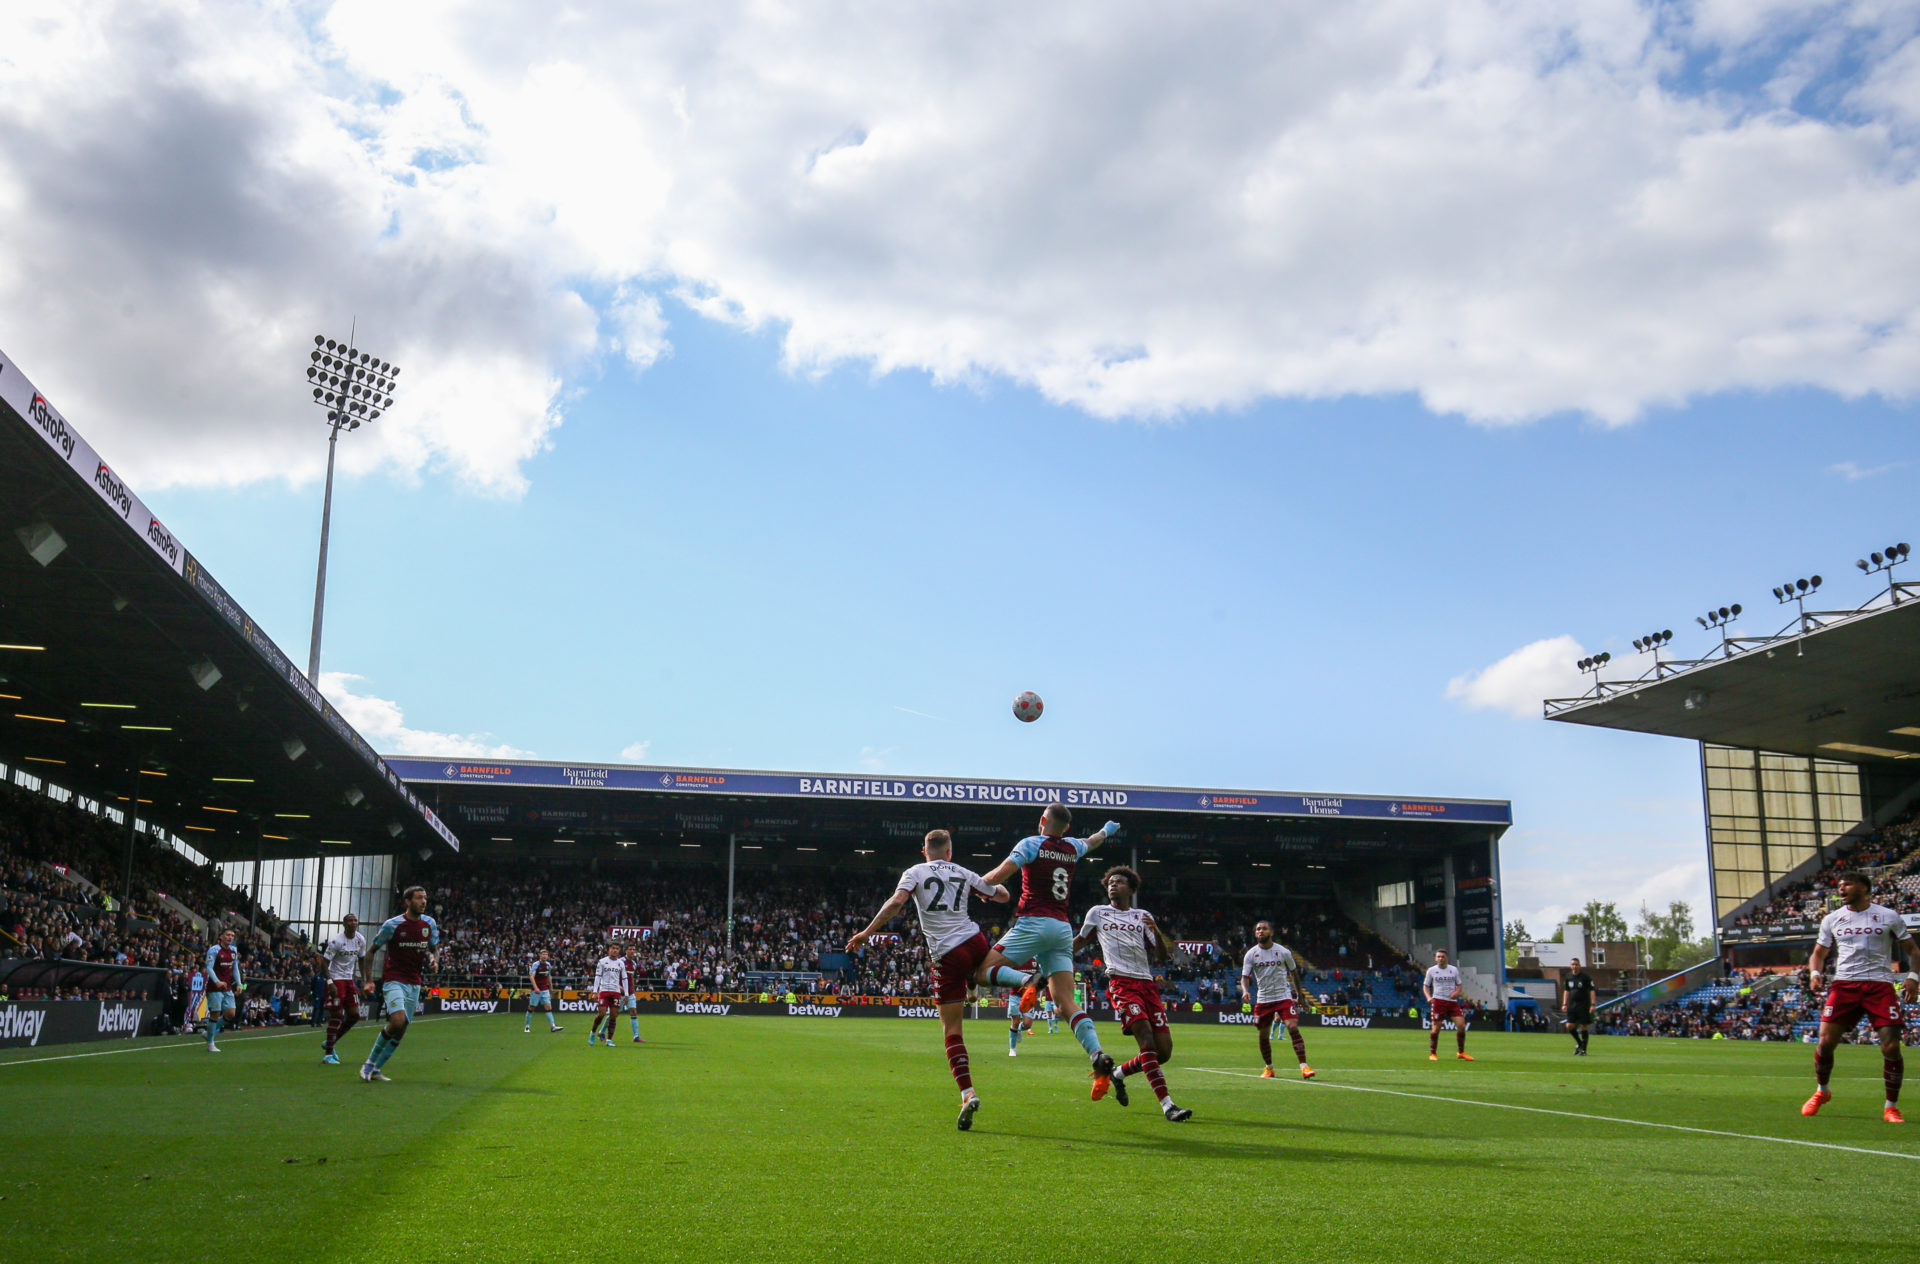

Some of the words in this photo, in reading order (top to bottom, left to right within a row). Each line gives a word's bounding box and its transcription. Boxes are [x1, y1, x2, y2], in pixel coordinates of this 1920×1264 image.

[28, 391, 75, 461] AstroPay
[94, 461, 132, 520] AstroPay
[147, 517, 178, 567] AstroPay
[460, 765, 512, 776] BARNFIELD
[563, 767, 609, 779] Barnfield
[570, 777, 605, 788] Homes
[676, 775, 726, 786] BARNFIELD
[799, 778, 906, 797] BARNFIELD
[912, 783, 1061, 803] CONSTRUCTION
[1067, 789, 1128, 805] STAND
[1212, 796, 1258, 806] BARNFIELD
[1302, 797, 1343, 808] Barnfield
[1309, 806, 1340, 816] Homes
[1401, 804, 1446, 814] BARNFIELD
[1052, 867, 1069, 901] 8
[923, 876, 967, 912] 27
[1102, 923, 1143, 933] CAZOO
[1836, 927, 1883, 937] CAZOO
[868, 934, 888, 947] XIT
[440, 999, 498, 1013] betway
[675, 1001, 731, 1016] betway
[789, 1003, 842, 1018] betway
[898, 1005, 941, 1018] betwa
[1290, 1006, 1297, 1016] 6
[1888, 1005, 1900, 1020] 5
[0, 1004, 46, 1047] etway
[98, 1001, 142, 1039] betway
[1321, 1015, 1371, 1030] betway
